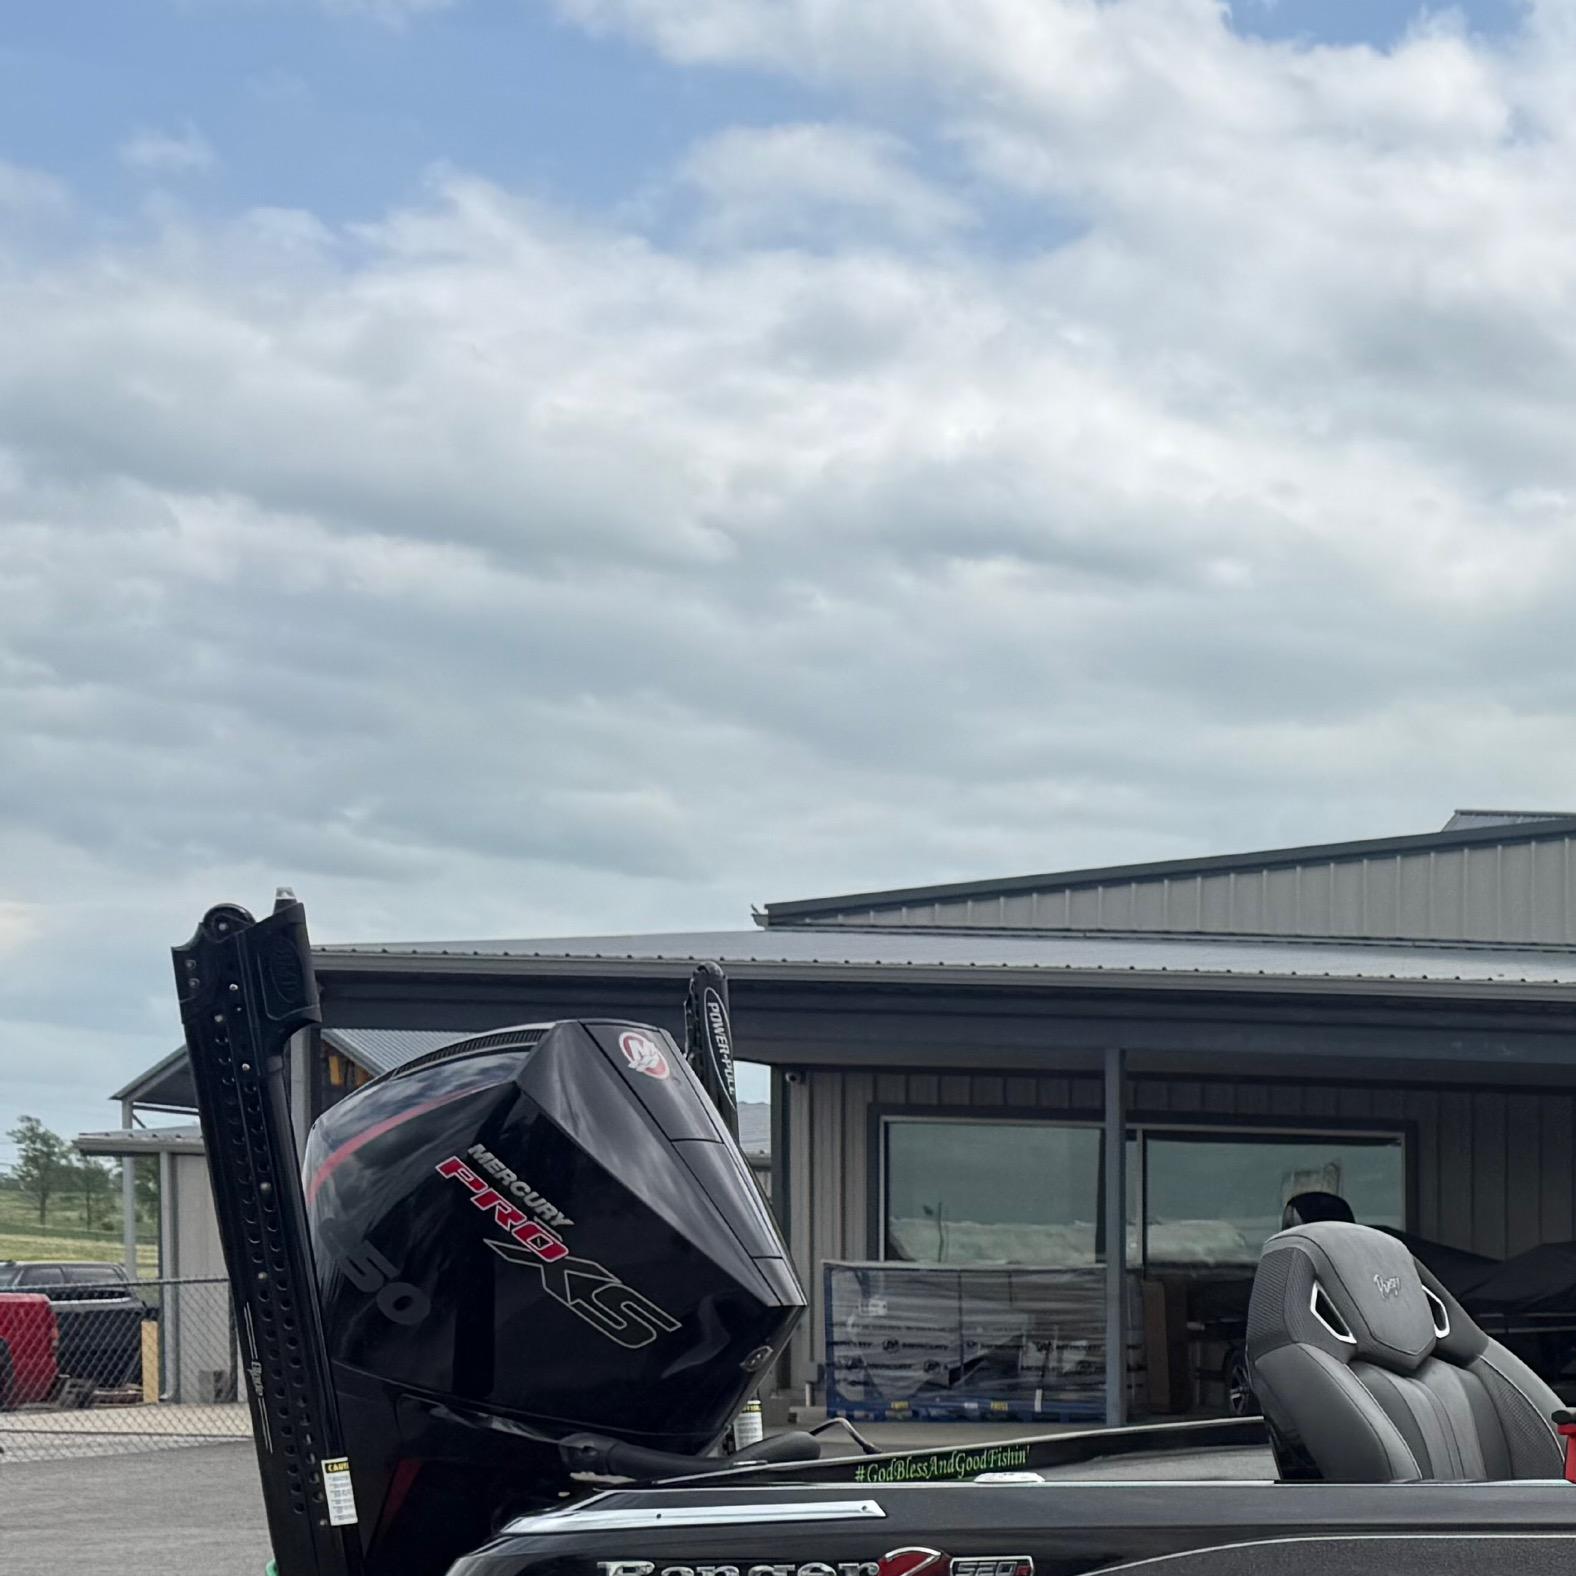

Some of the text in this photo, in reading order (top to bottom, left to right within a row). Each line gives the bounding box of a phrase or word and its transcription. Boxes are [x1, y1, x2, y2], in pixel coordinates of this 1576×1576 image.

[435, 1156, 570, 1263] PRO
[466, 1143, 575, 1228] MERCURY
[482, 1237, 682, 1349] XS
